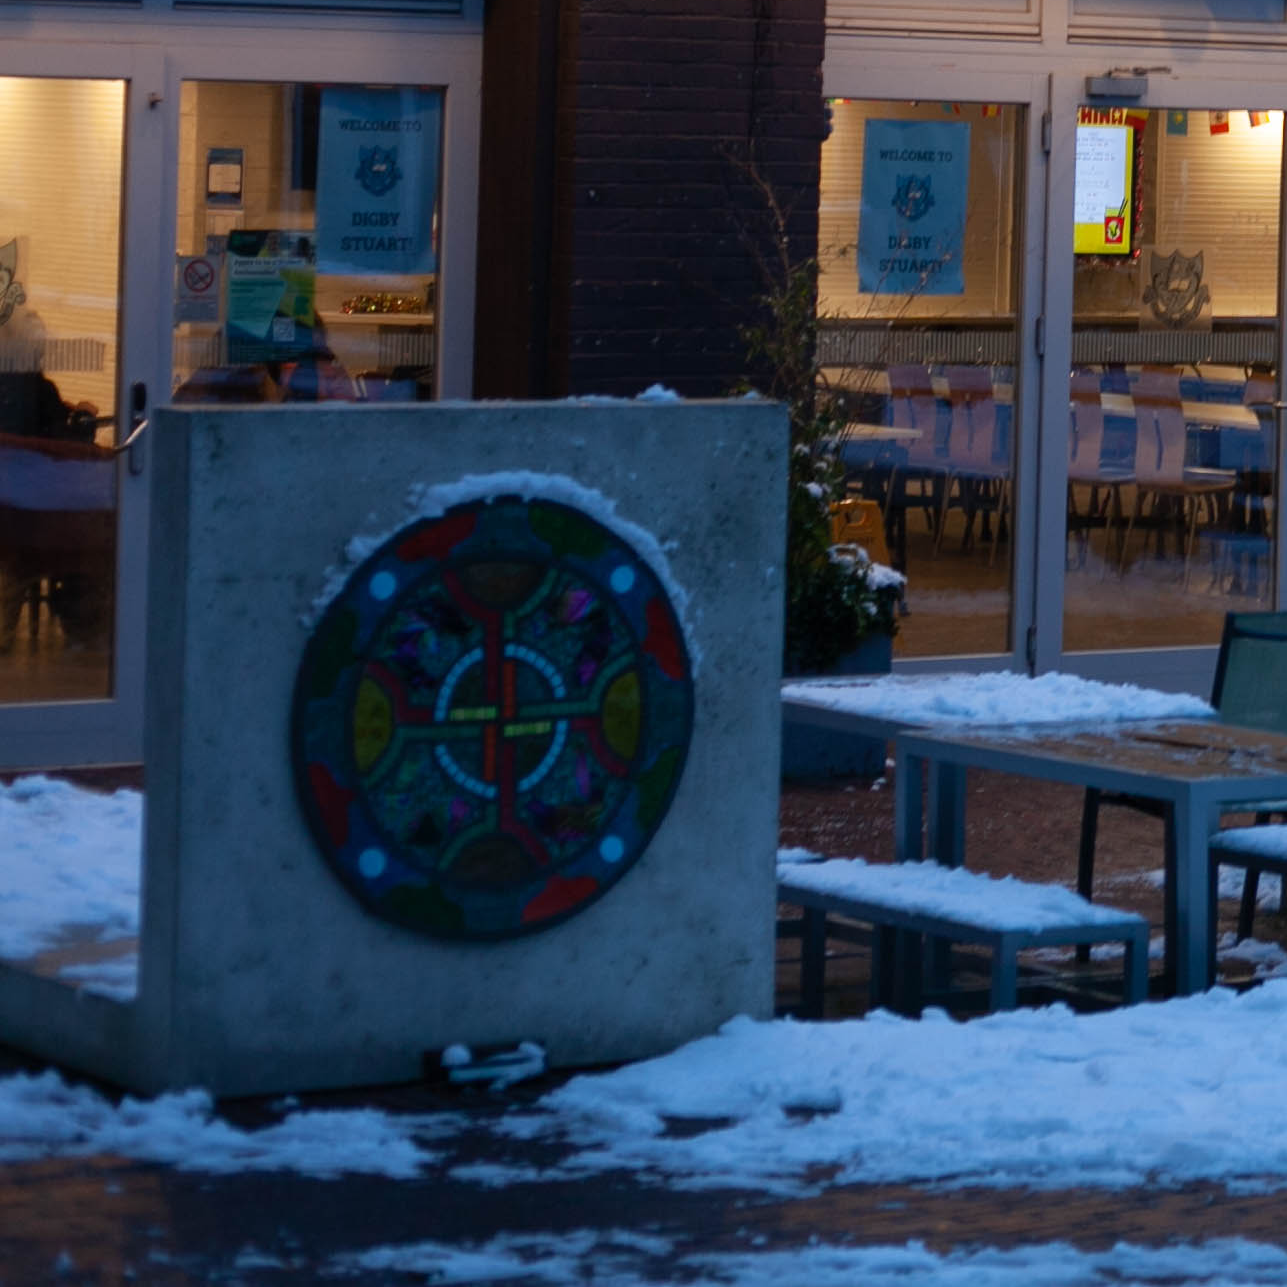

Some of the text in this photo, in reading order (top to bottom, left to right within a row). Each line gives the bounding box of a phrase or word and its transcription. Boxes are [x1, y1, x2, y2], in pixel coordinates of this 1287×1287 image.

[1077, 106, 1124, 124] HINA
[339, 120, 422, 132] WELCOME TO
[879, 149, 953, 162] WELCOME TO
[351, 212, 400, 227] DIGBY
